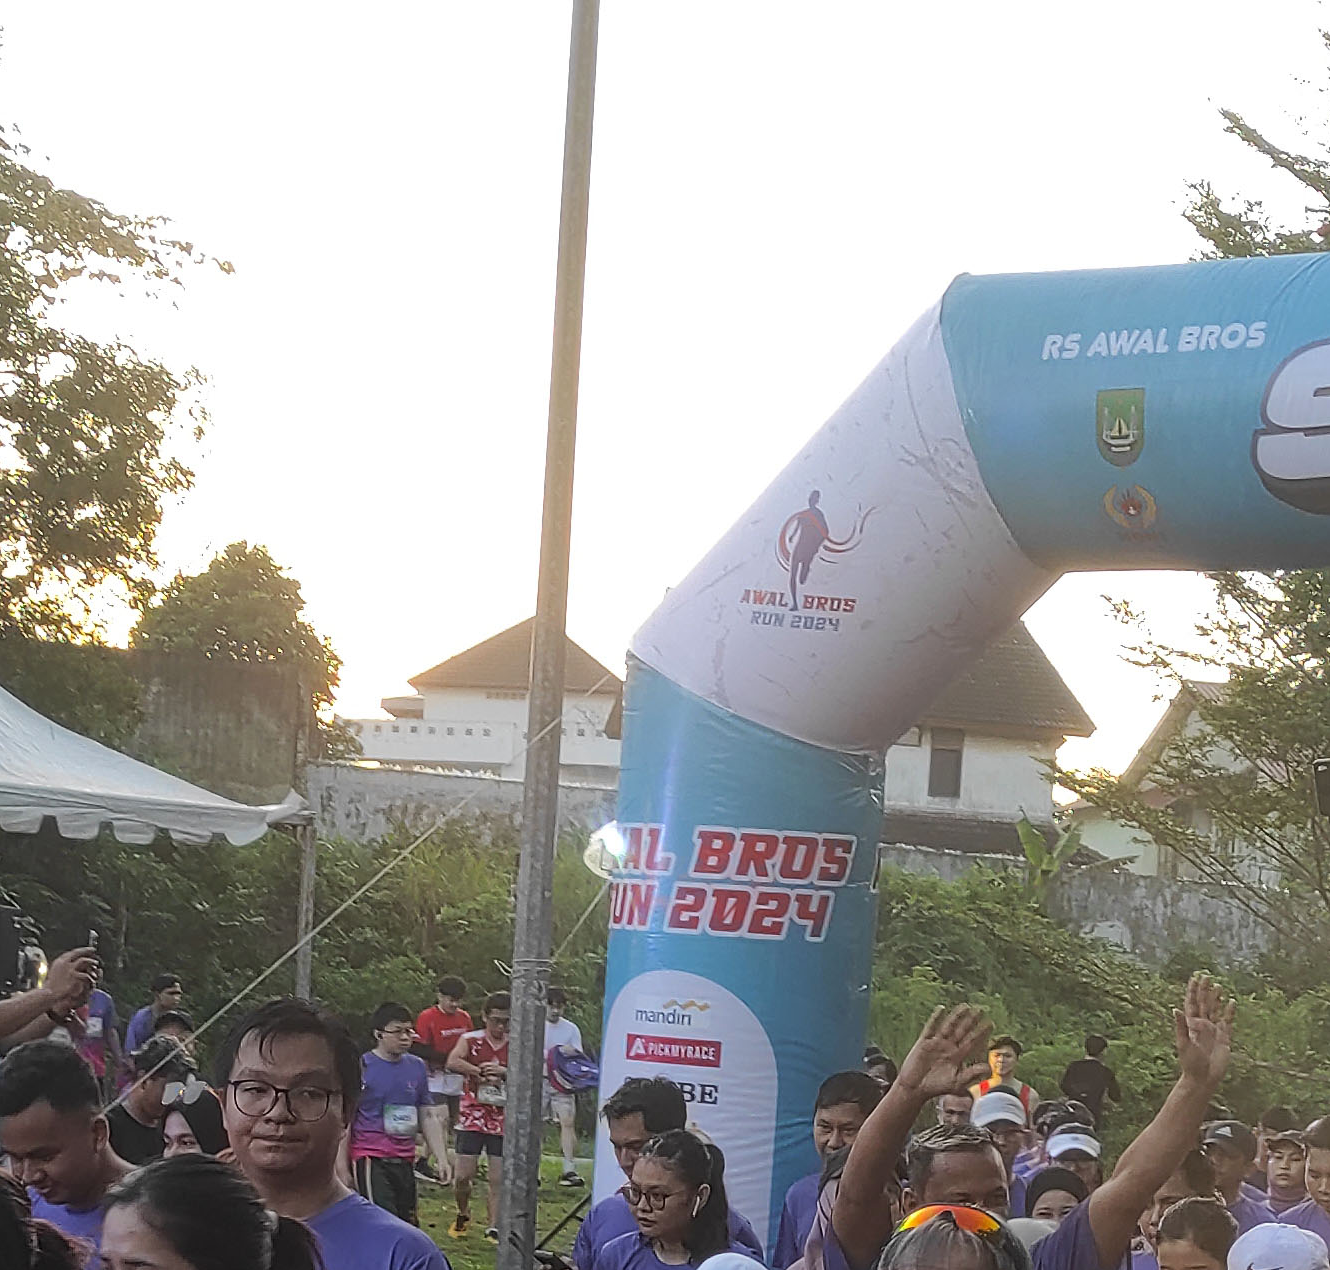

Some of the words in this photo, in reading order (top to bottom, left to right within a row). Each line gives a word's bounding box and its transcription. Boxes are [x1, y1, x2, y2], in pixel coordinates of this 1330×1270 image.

[1041, 333, 1082, 360] RS
[1086, 327, 1169, 358] AWAL
[1177, 321, 1268, 352] BROS
[739, 589, 789, 607] AWAL
[802, 595, 857, 613] BROS
[750, 611, 786, 628] RUN
[790, 615, 840, 631] 2024
[691, 828, 856, 884] BROS
[611, 881, 656, 929] UN
[667, 885, 833, 940] 2024
[635, 1008, 692, 1026] mandiri
[648, 1042, 716, 1061] PICKMYRACE
